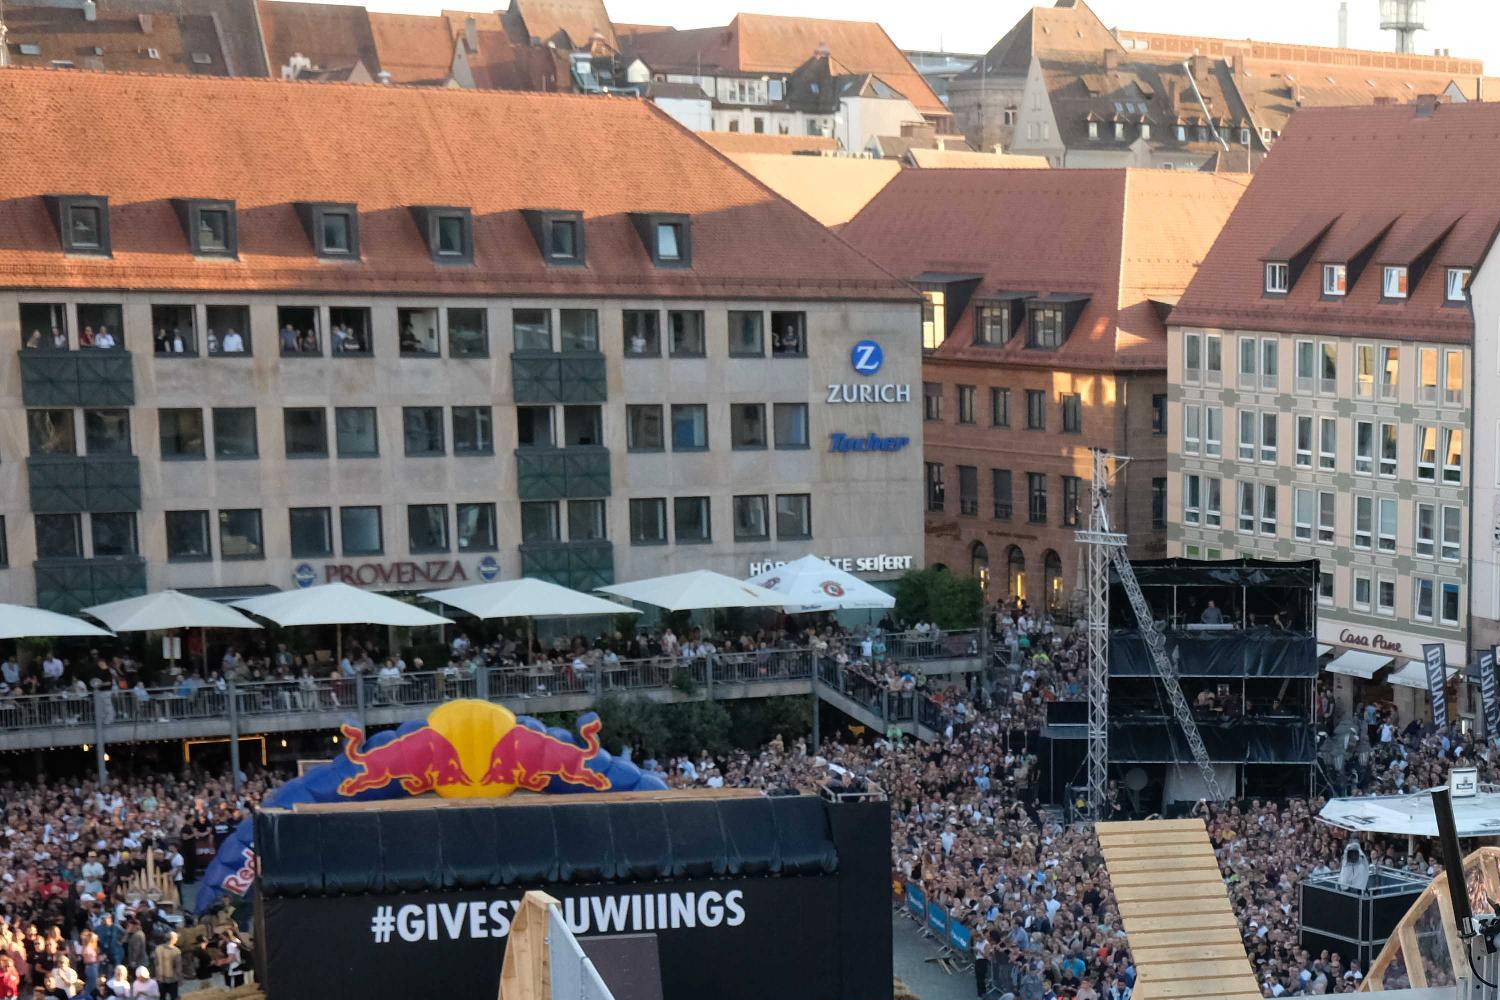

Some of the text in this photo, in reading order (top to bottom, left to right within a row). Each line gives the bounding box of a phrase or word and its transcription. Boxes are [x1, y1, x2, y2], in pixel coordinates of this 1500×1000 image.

[826, 383, 911, 403] ZURICH
[325, 561, 469, 585] PROVENZA
[1340, 628, 1403, 652] Casa Pane
[372, 890, 745, 943] #GIVESUWIIINGS
